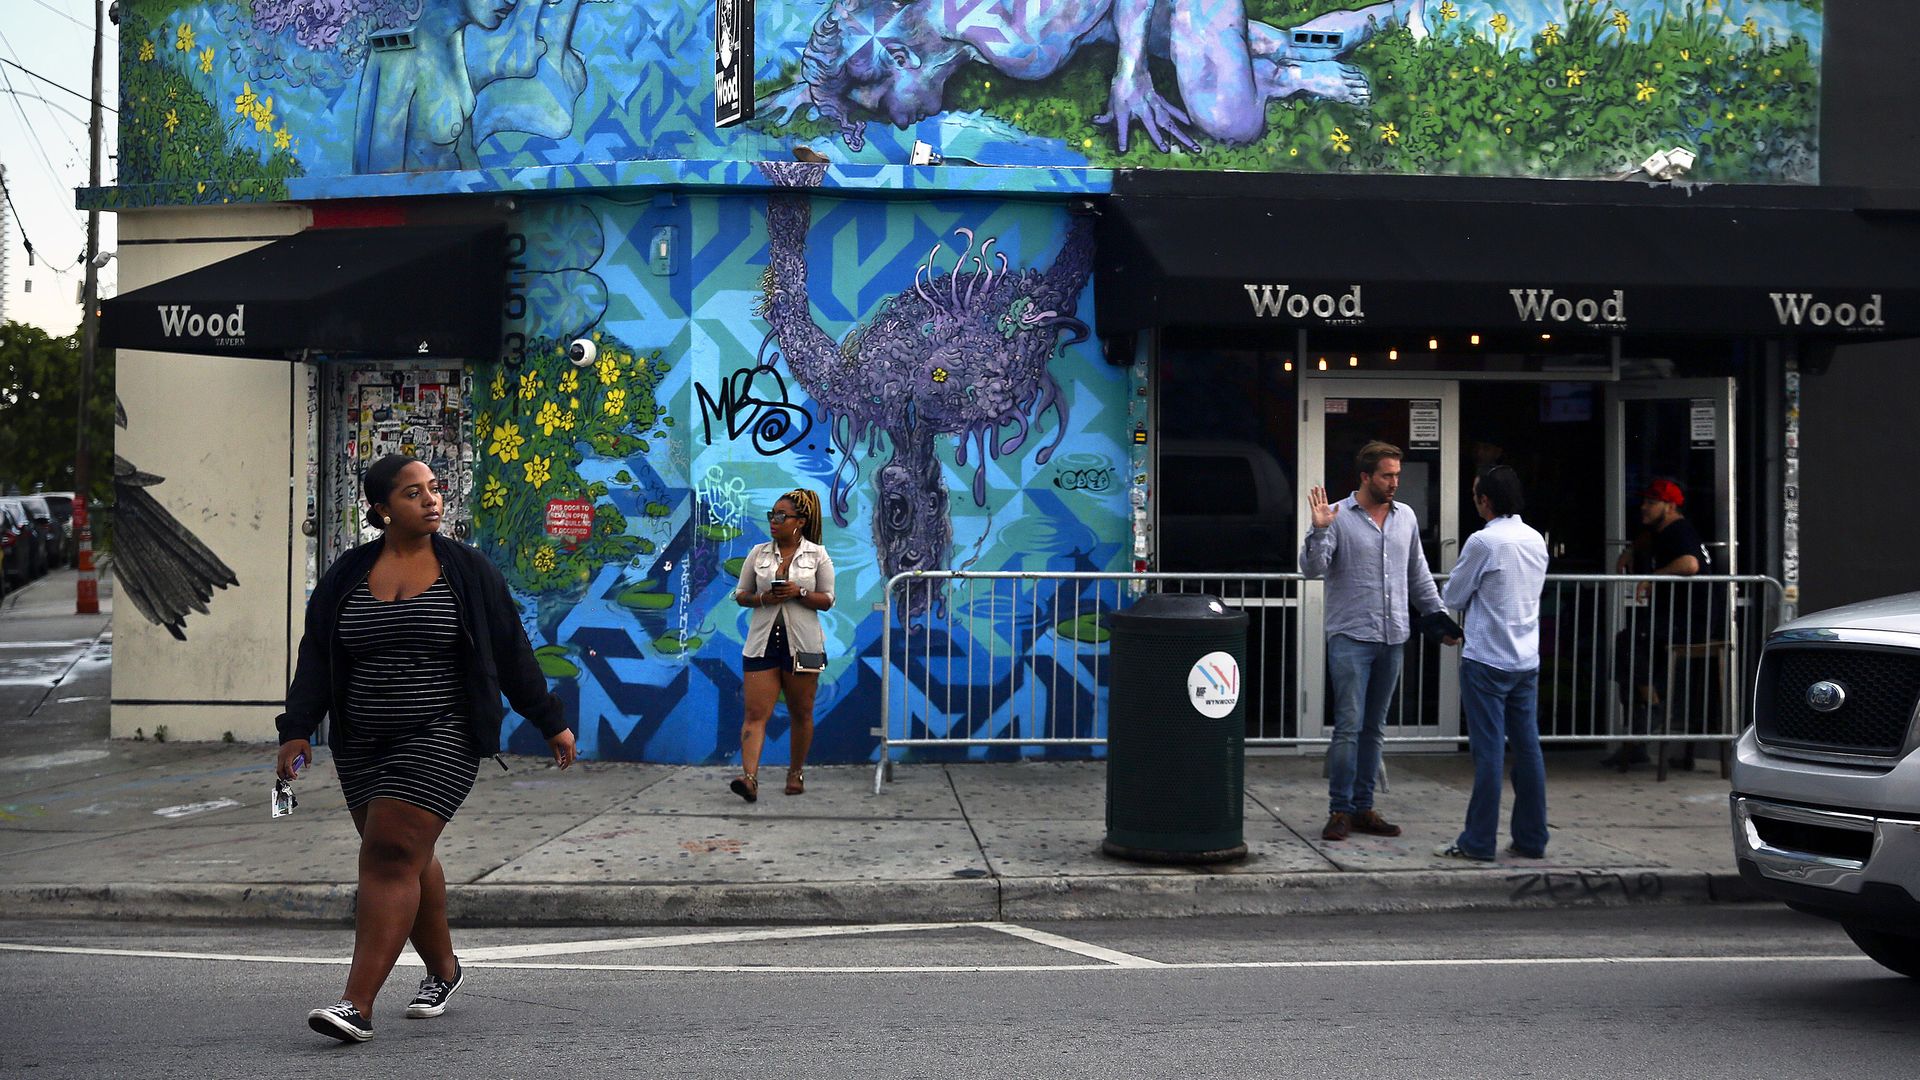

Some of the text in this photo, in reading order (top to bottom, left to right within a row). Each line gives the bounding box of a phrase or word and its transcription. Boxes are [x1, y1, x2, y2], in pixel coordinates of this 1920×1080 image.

[716, 64, 738, 107] Wood
[1244, 284, 1365, 318] Wood
[1509, 289, 1627, 322] Wood
[1769, 293, 1885, 326] Wood
[157, 304, 246, 337] Wood
[215, 338, 246, 346] TAVERN
